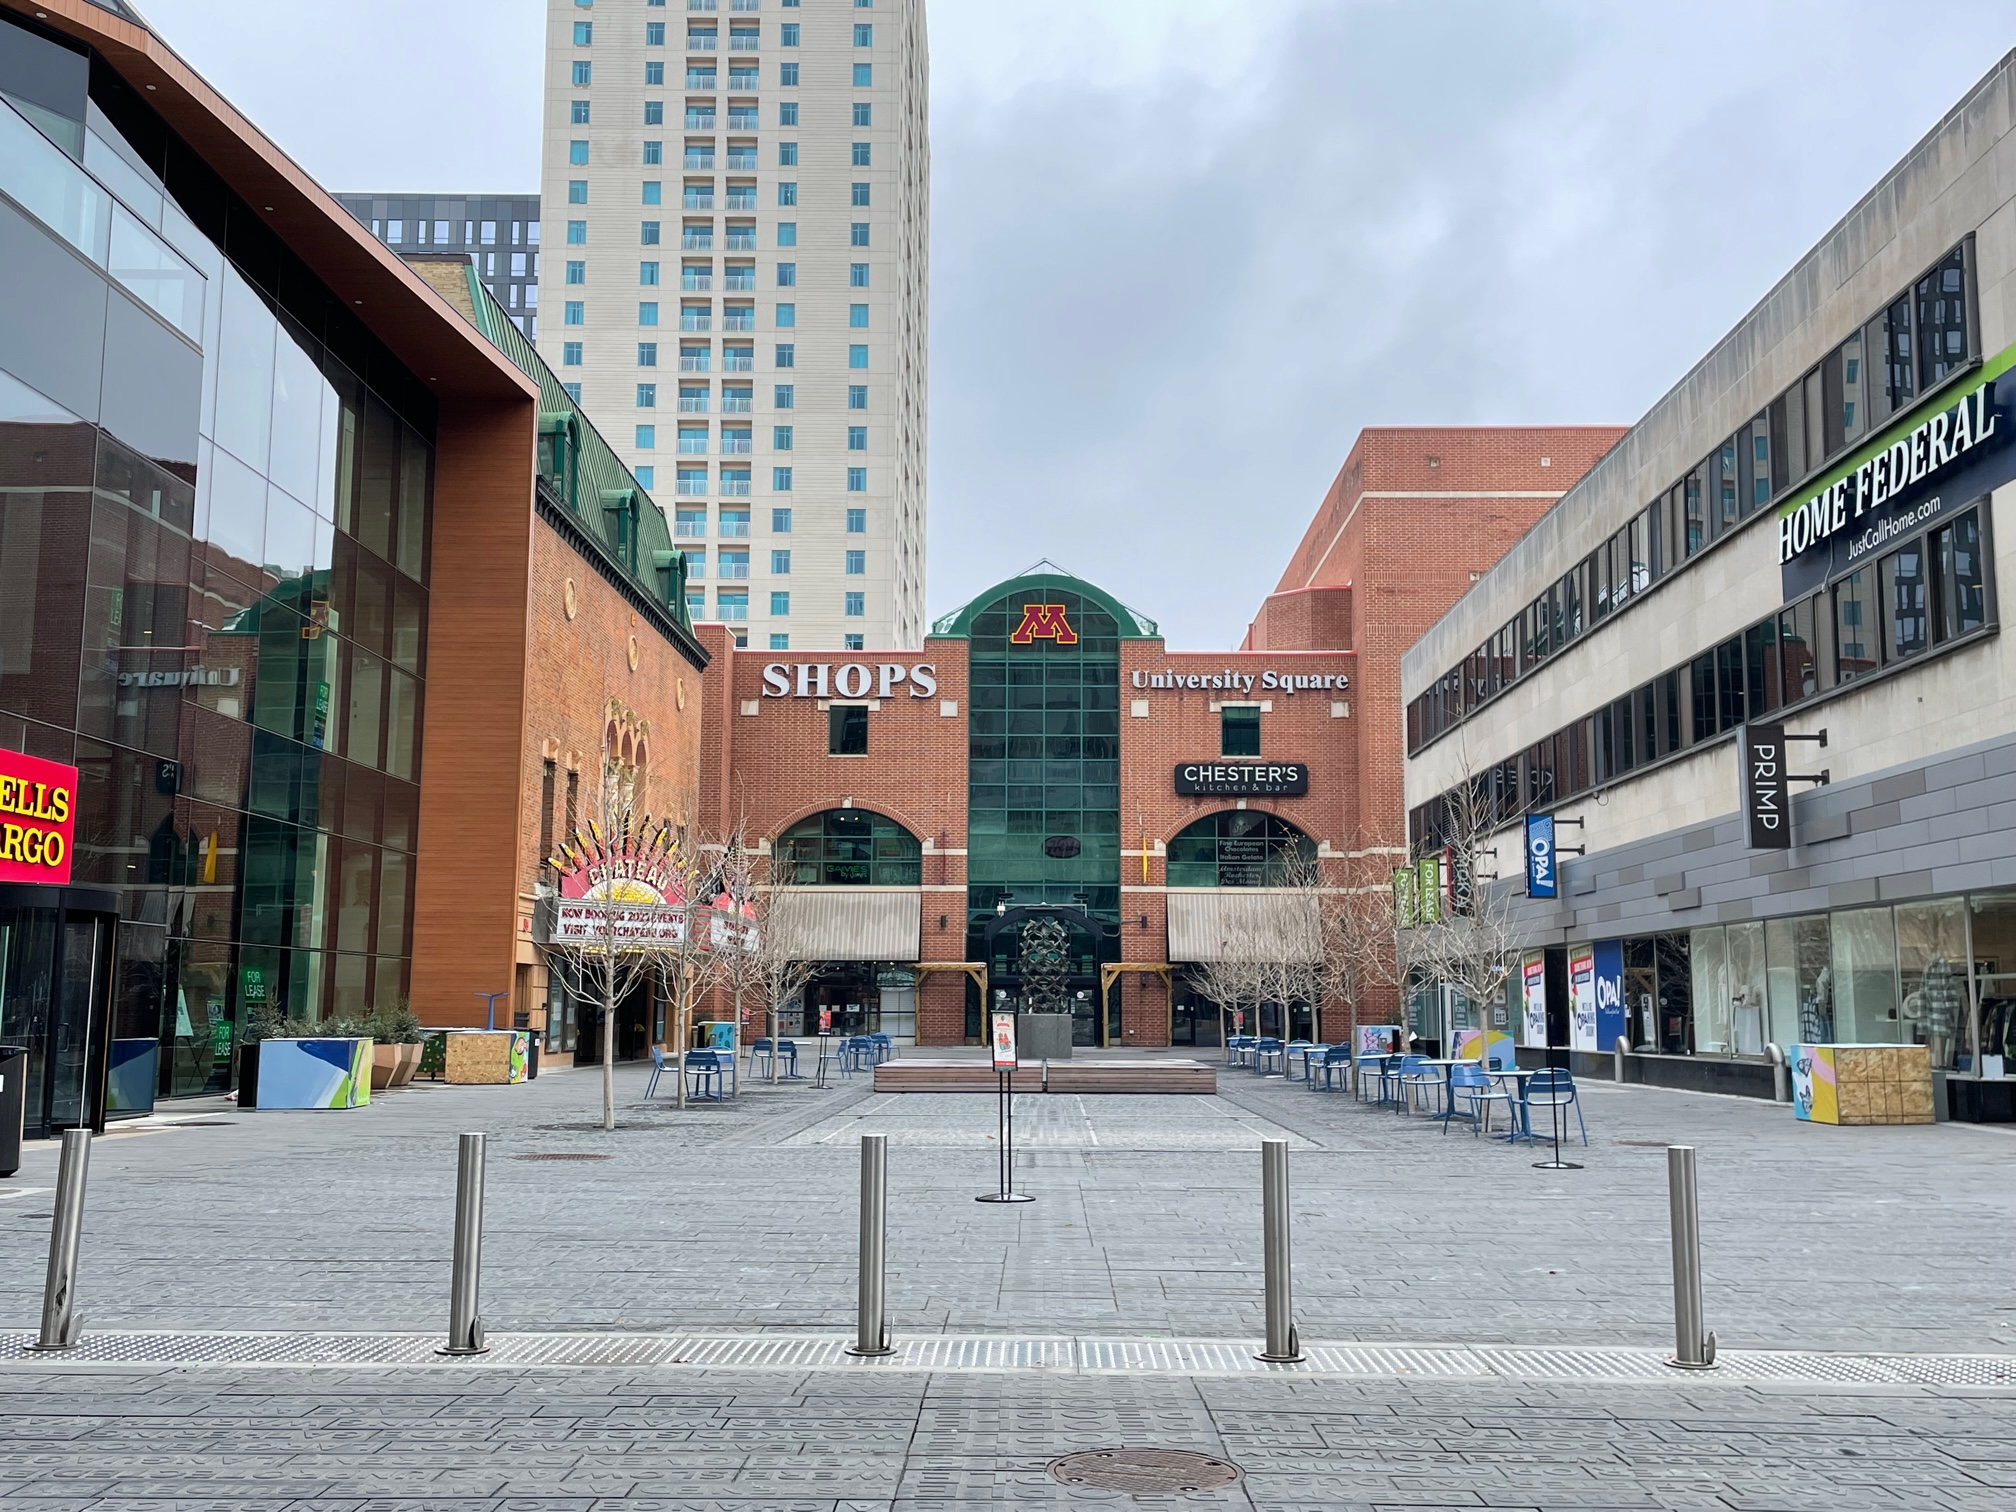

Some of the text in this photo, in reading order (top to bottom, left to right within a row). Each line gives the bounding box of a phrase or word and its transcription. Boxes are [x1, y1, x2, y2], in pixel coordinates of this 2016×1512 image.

[1778, 382, 1995, 565] HOME FEDERAL
[1848, 496, 1940, 560] JustCallHome.com
[762, 664, 937, 698] SHOPS
[1131, 669, 1349, 694] University Square
[1184, 766, 1298, 782] CHESTER'S
[1194, 783, 1288, 792] kitchen & bar
[1753, 744, 1779, 830] PRIMP
[0, 774, 69, 823] ELLS
[0, 822, 65, 867] RGO
[1531, 837, 1554, 888] OPA!
[1425, 863, 1435, 919] FOR LEASE
[562, 907, 583, 918] NOW
[245, 985, 265, 997] LEASE
[247, 971, 260, 982] FOR
[1597, 975, 1621, 1010] OPA!
[215, 1042, 231, 1056] LEASE
[219, 1026, 230, 1040] FOR
